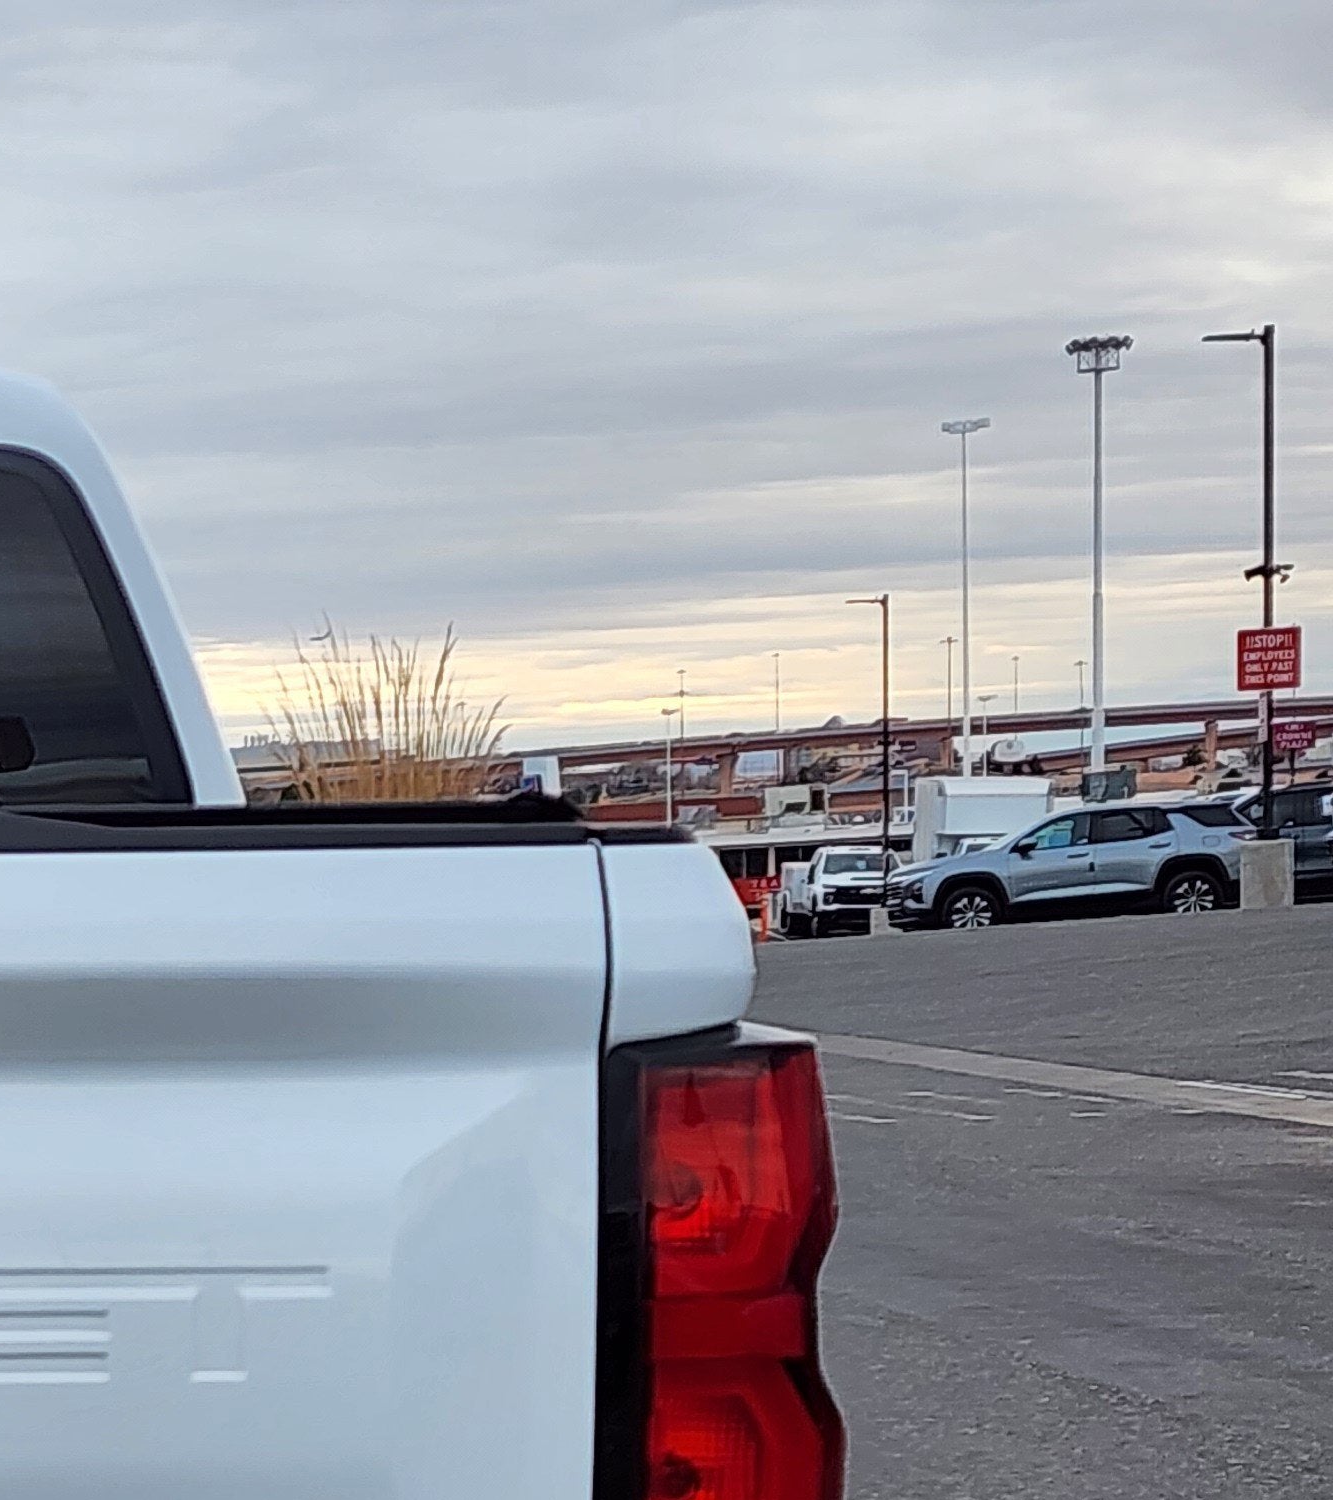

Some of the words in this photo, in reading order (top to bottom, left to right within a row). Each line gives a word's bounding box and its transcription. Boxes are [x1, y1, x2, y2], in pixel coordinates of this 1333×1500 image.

[1243, 649, 1295, 662] EMPLOYEES
[1245, 663, 1269, 673] ONLY
[1270, 661, 1293, 671] PAST
[1244, 674, 1264, 684] THIS
[1266, 673, 1294, 683] POINT
